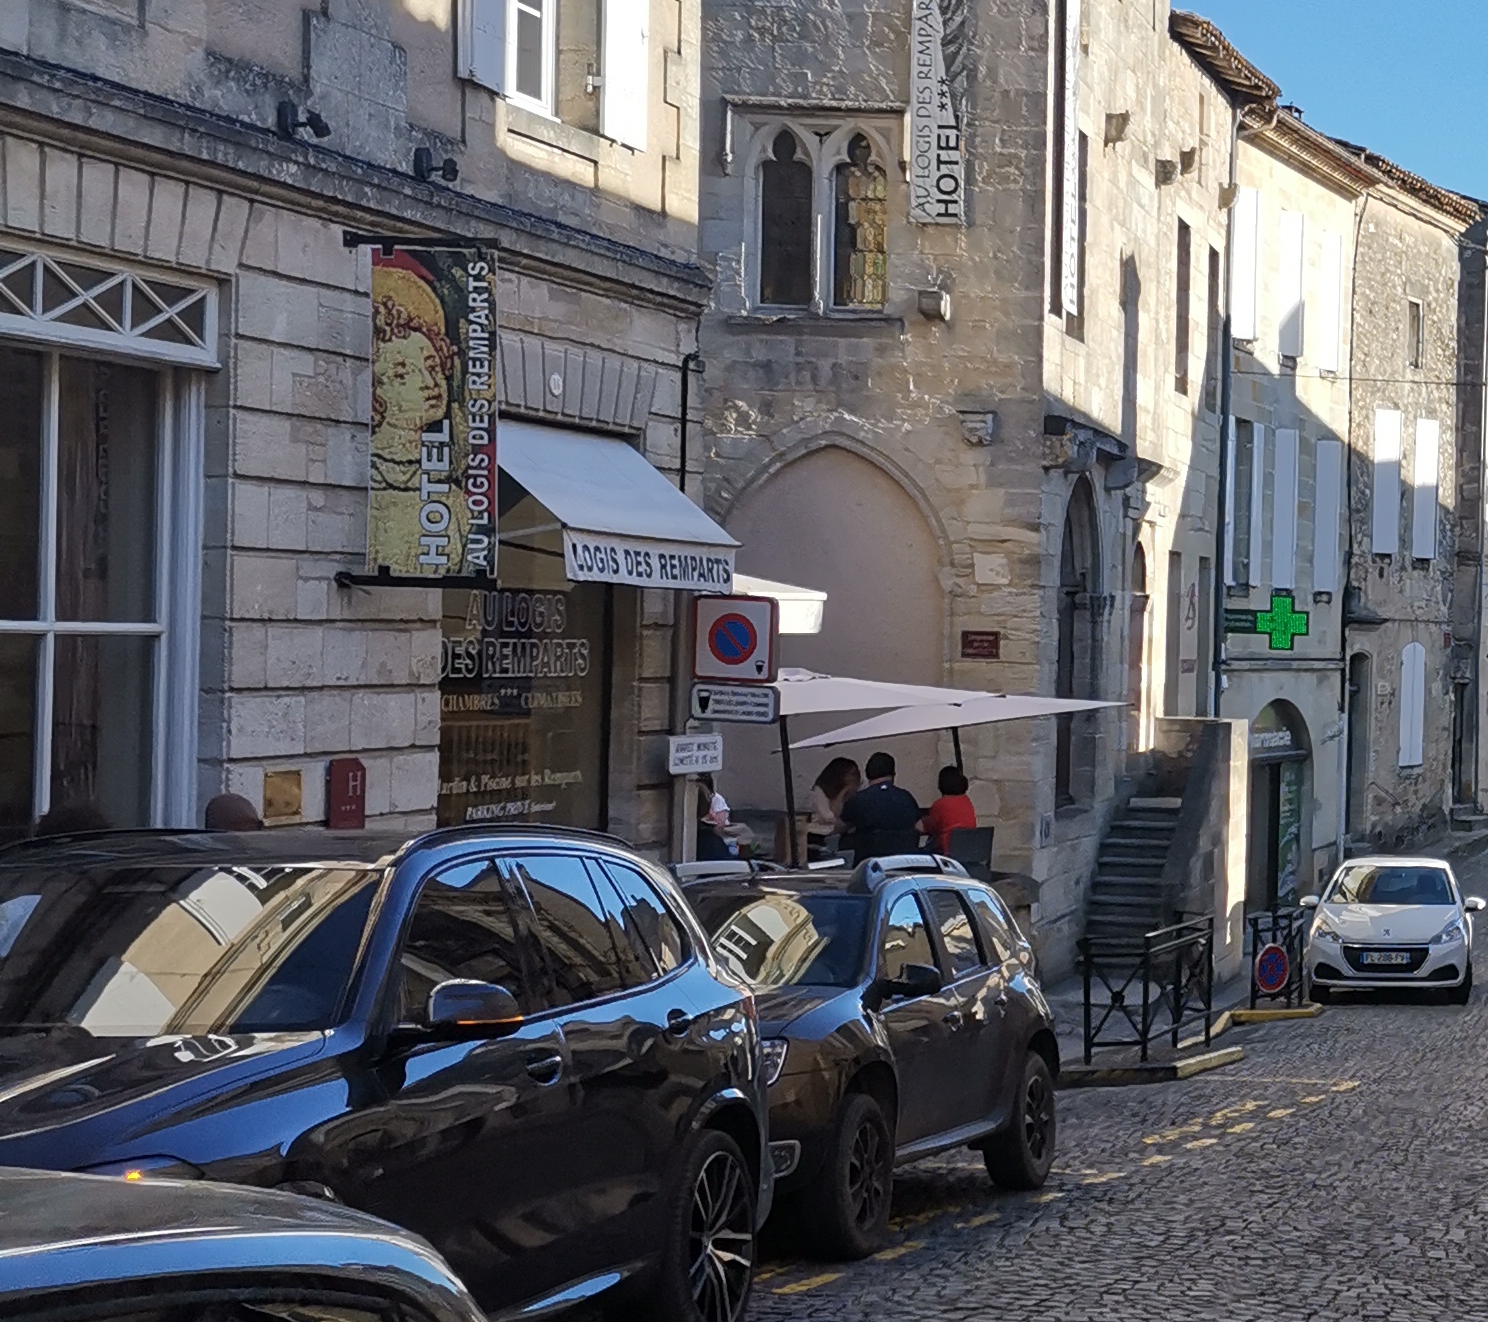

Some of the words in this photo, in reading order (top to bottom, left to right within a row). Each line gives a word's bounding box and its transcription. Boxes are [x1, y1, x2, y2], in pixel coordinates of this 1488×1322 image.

[917, 86, 932, 119] DES
[915, 123, 932, 179] LOGIS
[936, 114, 960, 218] HOTEL
[914, 184, 931, 217] AU
[468, 261, 490, 390] REMPARTS
[468, 398, 489, 446] DES
[419, 419, 450, 566] HOTEL
[467, 455, 489, 528] LOGIS
[466, 534, 489, 566] AU
[572, 542, 620, 575] LOGIS
[624, 549, 653, 578] DES
[658, 553, 731, 584] REMPARTS
[465, 589, 499, 629] AU
[502, 592, 567, 633] LOGIS
[482, 638, 590, 678] REMPARTS
[347, 771, 362, 797] H
